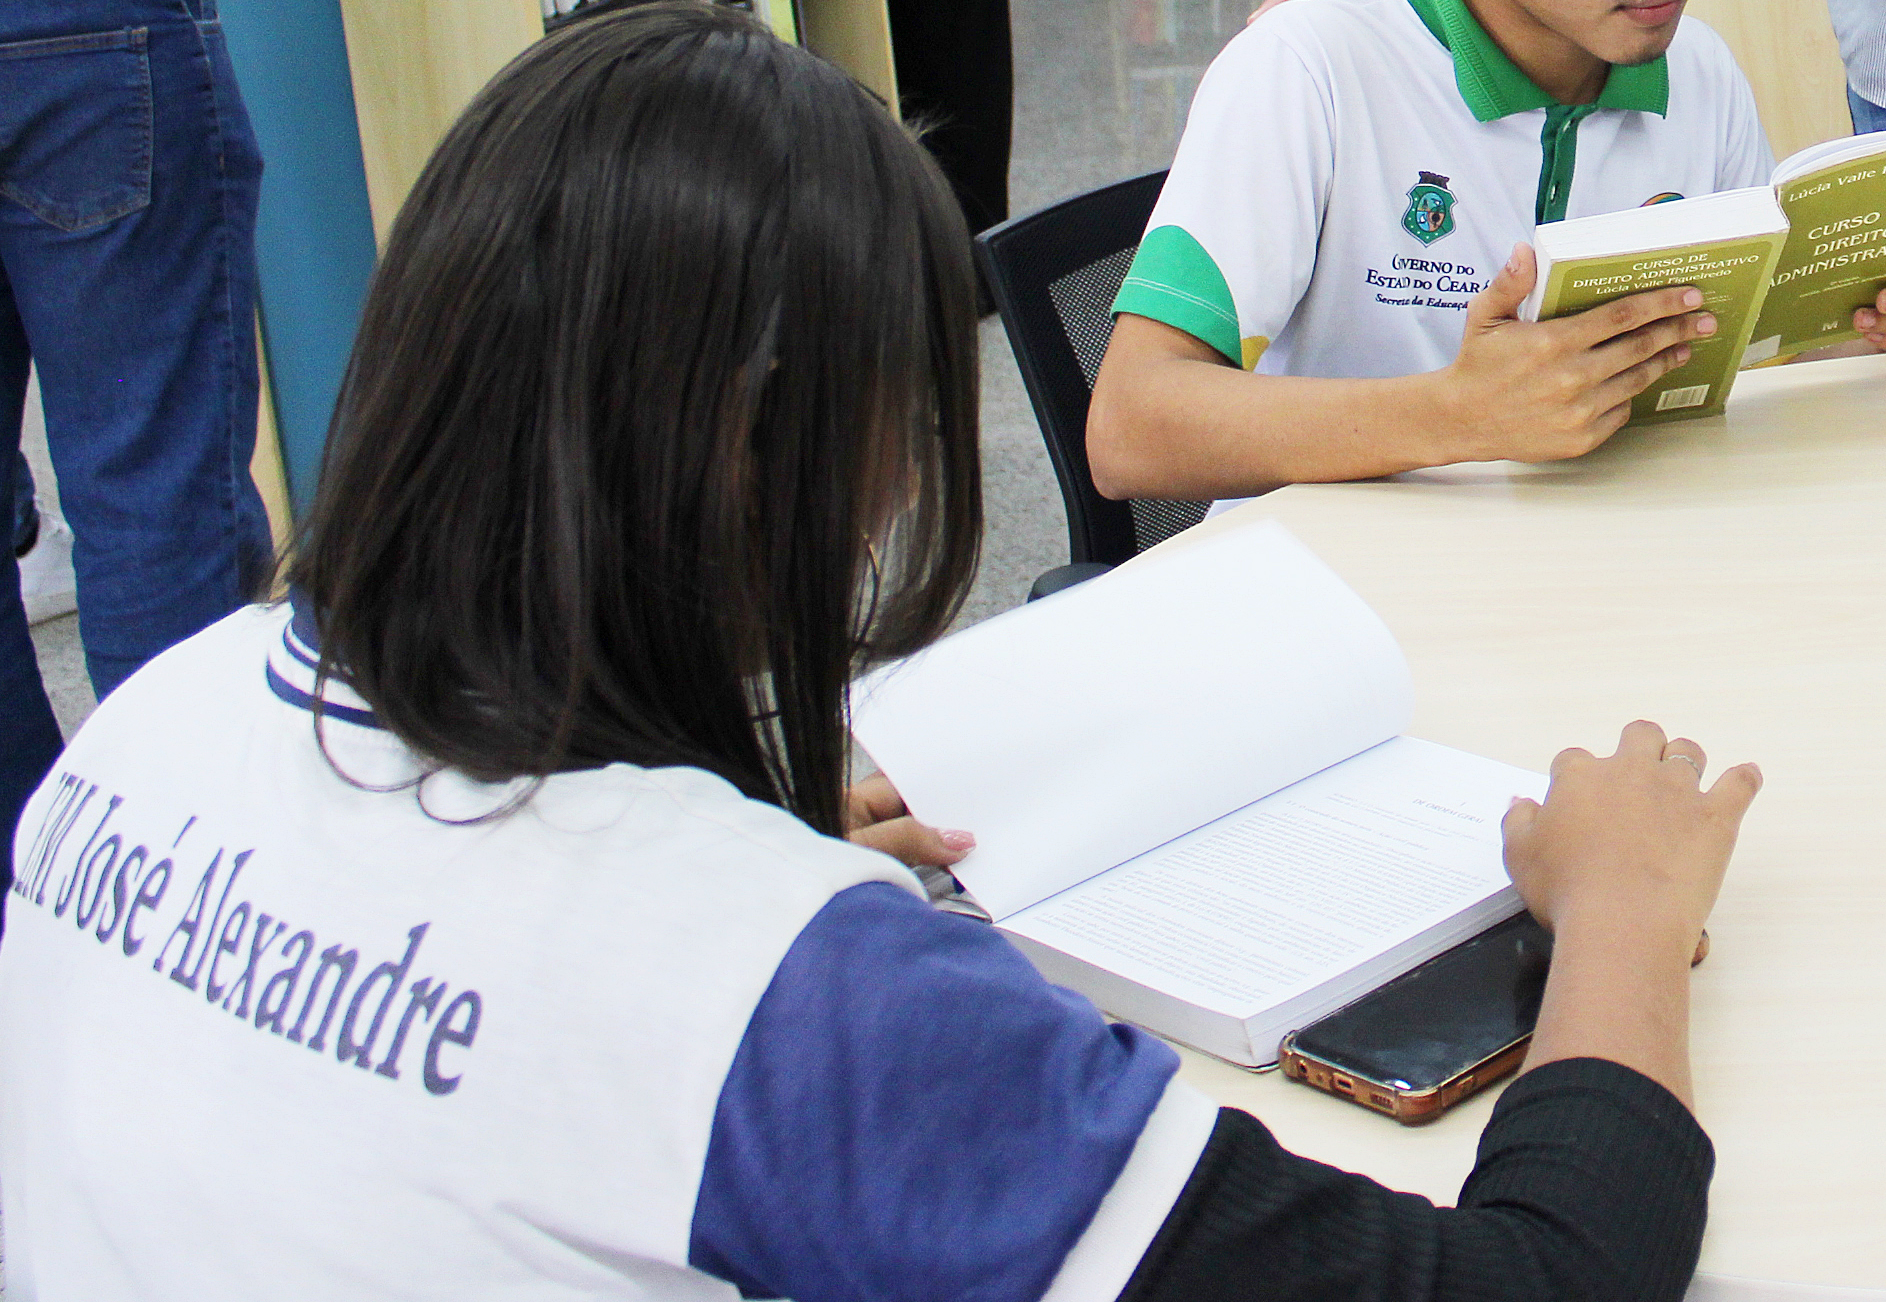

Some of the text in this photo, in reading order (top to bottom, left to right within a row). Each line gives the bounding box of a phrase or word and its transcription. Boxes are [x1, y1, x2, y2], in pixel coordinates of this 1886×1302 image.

[1789, 182, 1832, 202] Lúcia
[1837, 167, 1877, 186] Valle
[1807, 211, 1881, 240] CURSO
[1391, 253, 1475, 276] GVERNO DO
[1573, 255, 1760, 289] DIREITO ADMINISTRATIVO
[1632, 253, 1709, 271] CURSO DE
[1413, 279, 1433, 290] DO
[1596, 269, 1732, 295] Lúcia Valle Figueiredo
[1412, 295, 1424, 306] da
[1426, 297, 1469, 311] Educaçã
[55, 793, 198, 958] José
[152, 846, 483, 1097] Alexandre
